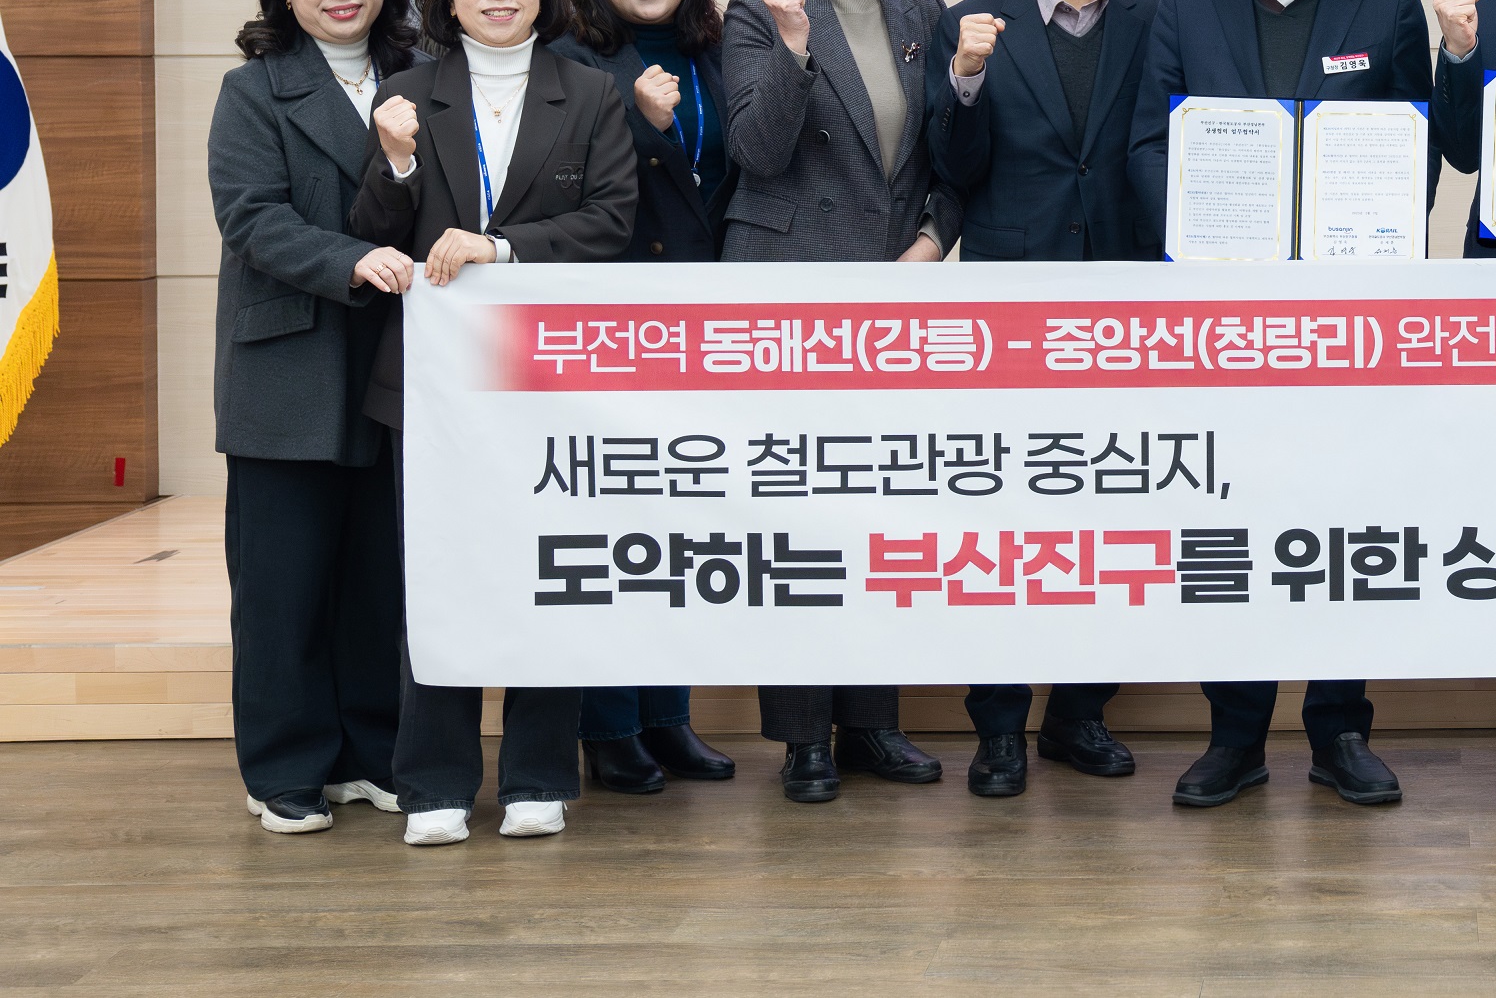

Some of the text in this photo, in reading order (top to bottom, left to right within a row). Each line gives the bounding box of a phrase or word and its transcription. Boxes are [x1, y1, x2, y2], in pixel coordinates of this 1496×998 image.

[533, 319, 687, 375] 부전역
[700, 318, 993, 373] 동해선(강릉)
[1042, 315, 1384, 371] 중앙선(청량리)
[1396, 314, 1496, 368] 완전
[533, 430, 1232, 500] 새로운 철도관광 중심지,
[534, 532, 847, 608] 도약하는
[865, 527, 1254, 608] 부산진구를
[1271, 525, 1428, 603] 위한
